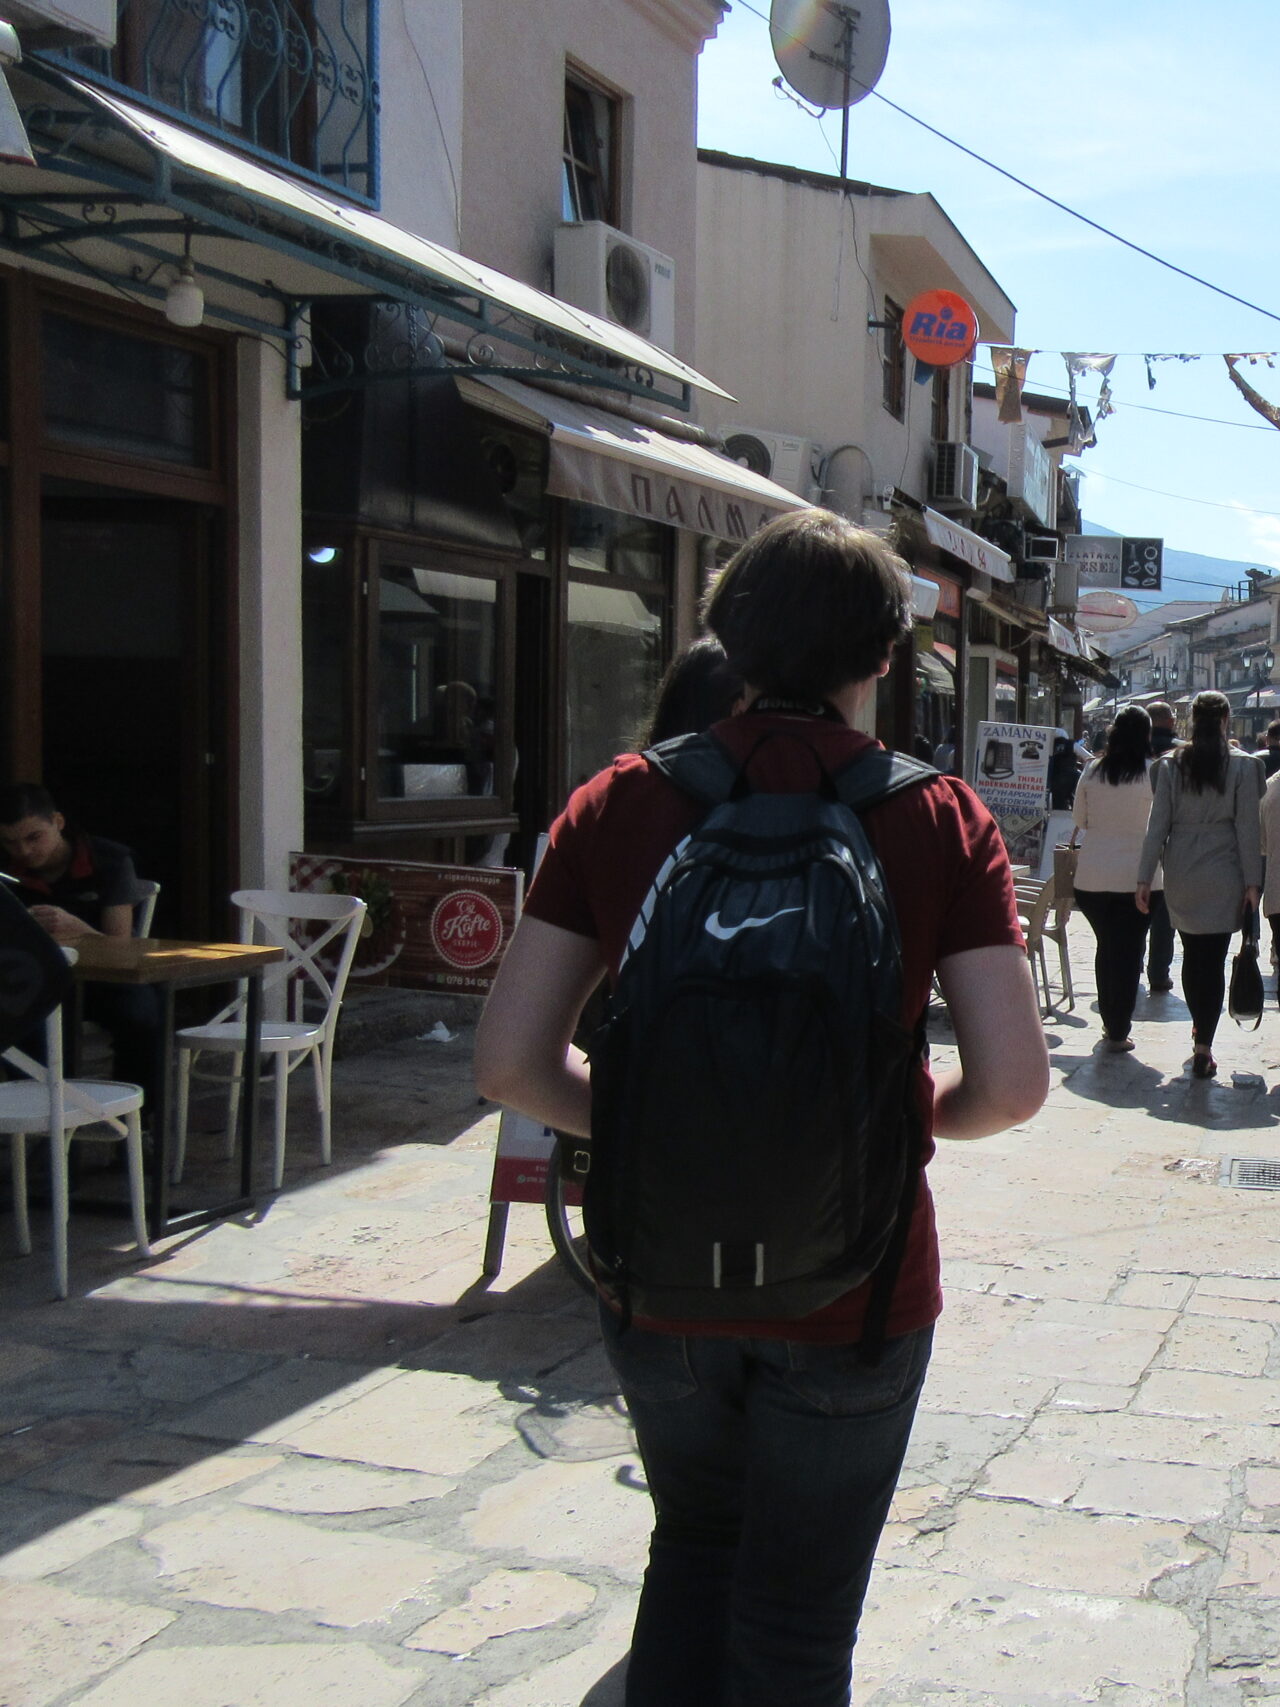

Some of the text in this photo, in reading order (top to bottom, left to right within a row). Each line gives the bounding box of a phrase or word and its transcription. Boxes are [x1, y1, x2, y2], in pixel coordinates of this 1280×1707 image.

[911, 306, 967, 341] Ria
[1080, 561, 1118, 573] ESEL
[983, 726, 1033, 739] ZAMAN
